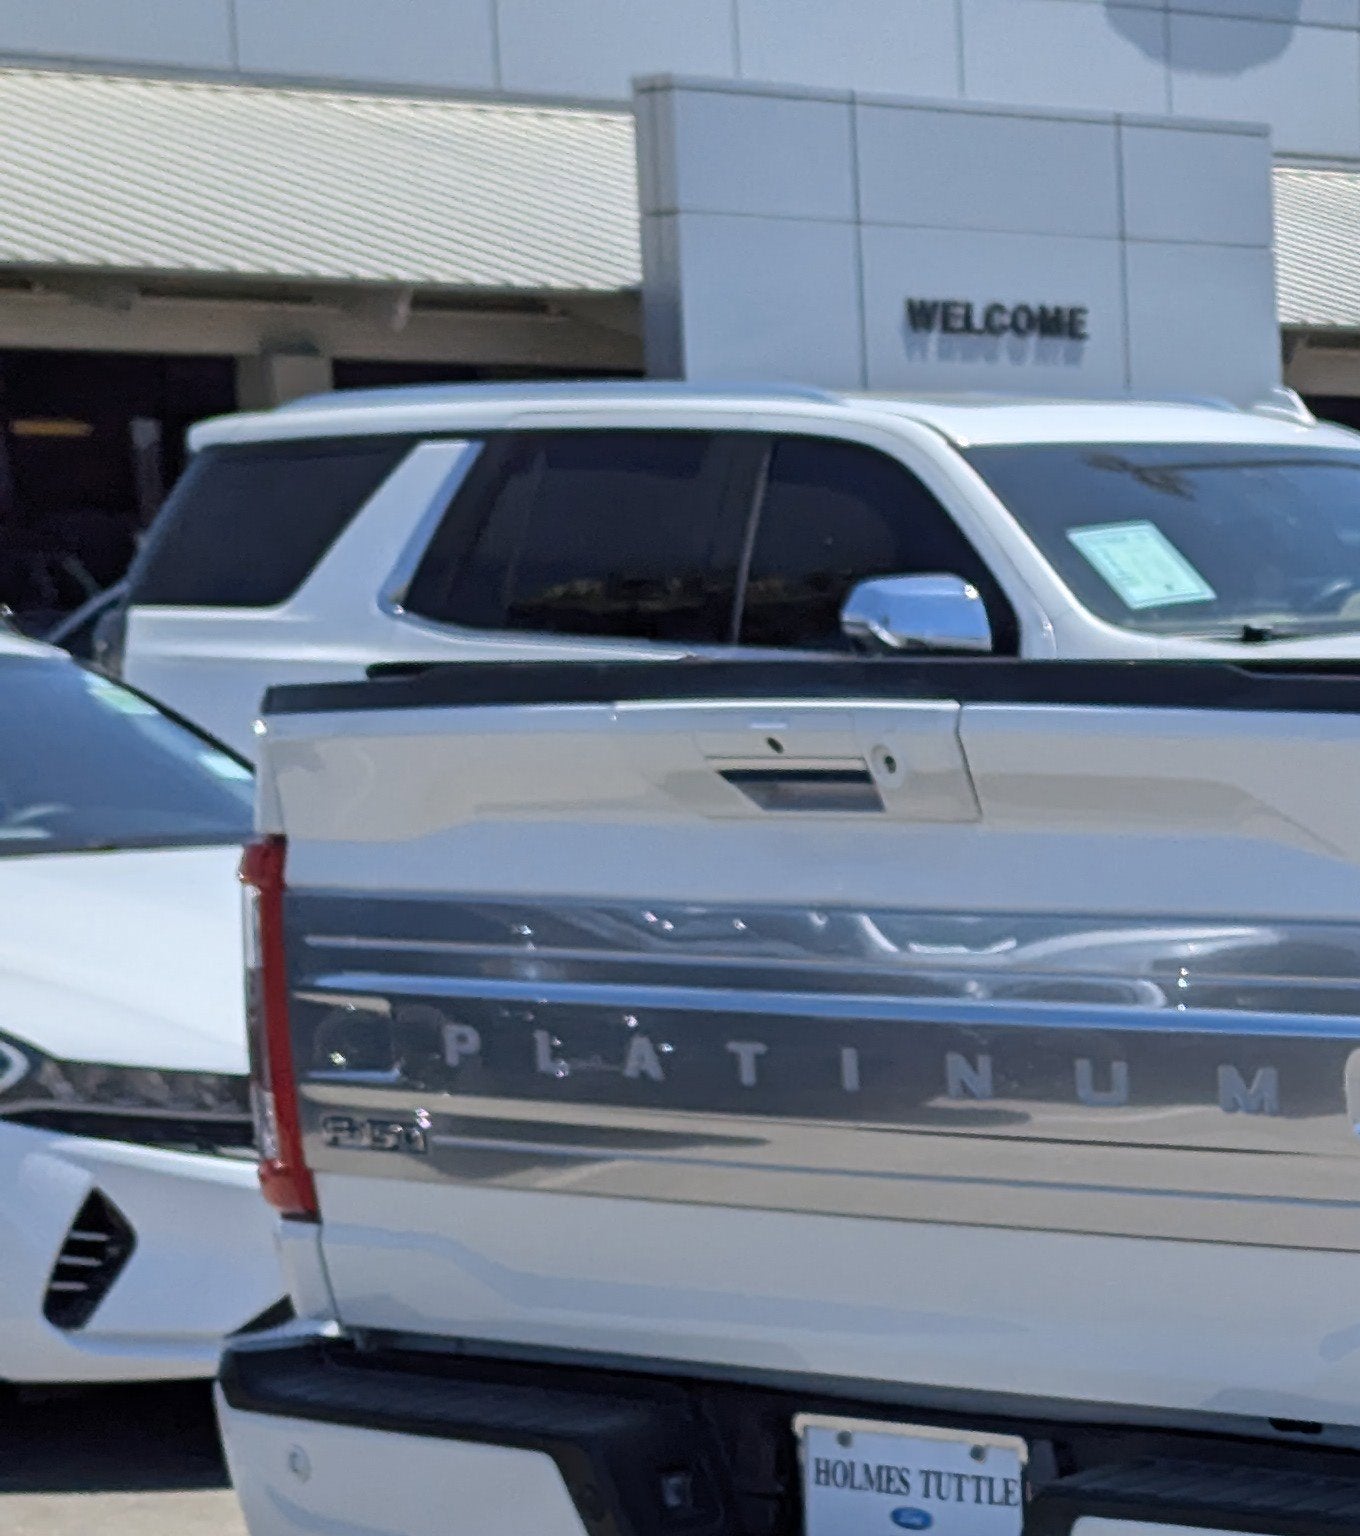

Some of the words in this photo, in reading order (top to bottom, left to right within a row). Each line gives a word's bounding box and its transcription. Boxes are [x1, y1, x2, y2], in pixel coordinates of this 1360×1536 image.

[906, 299, 1089, 340] WELCOME
[443, 1024, 1279, 1114] PLATINUM
[814, 1457, 911, 1496] HOLMES
[918, 1468, 1021, 1507] TUTTLE
